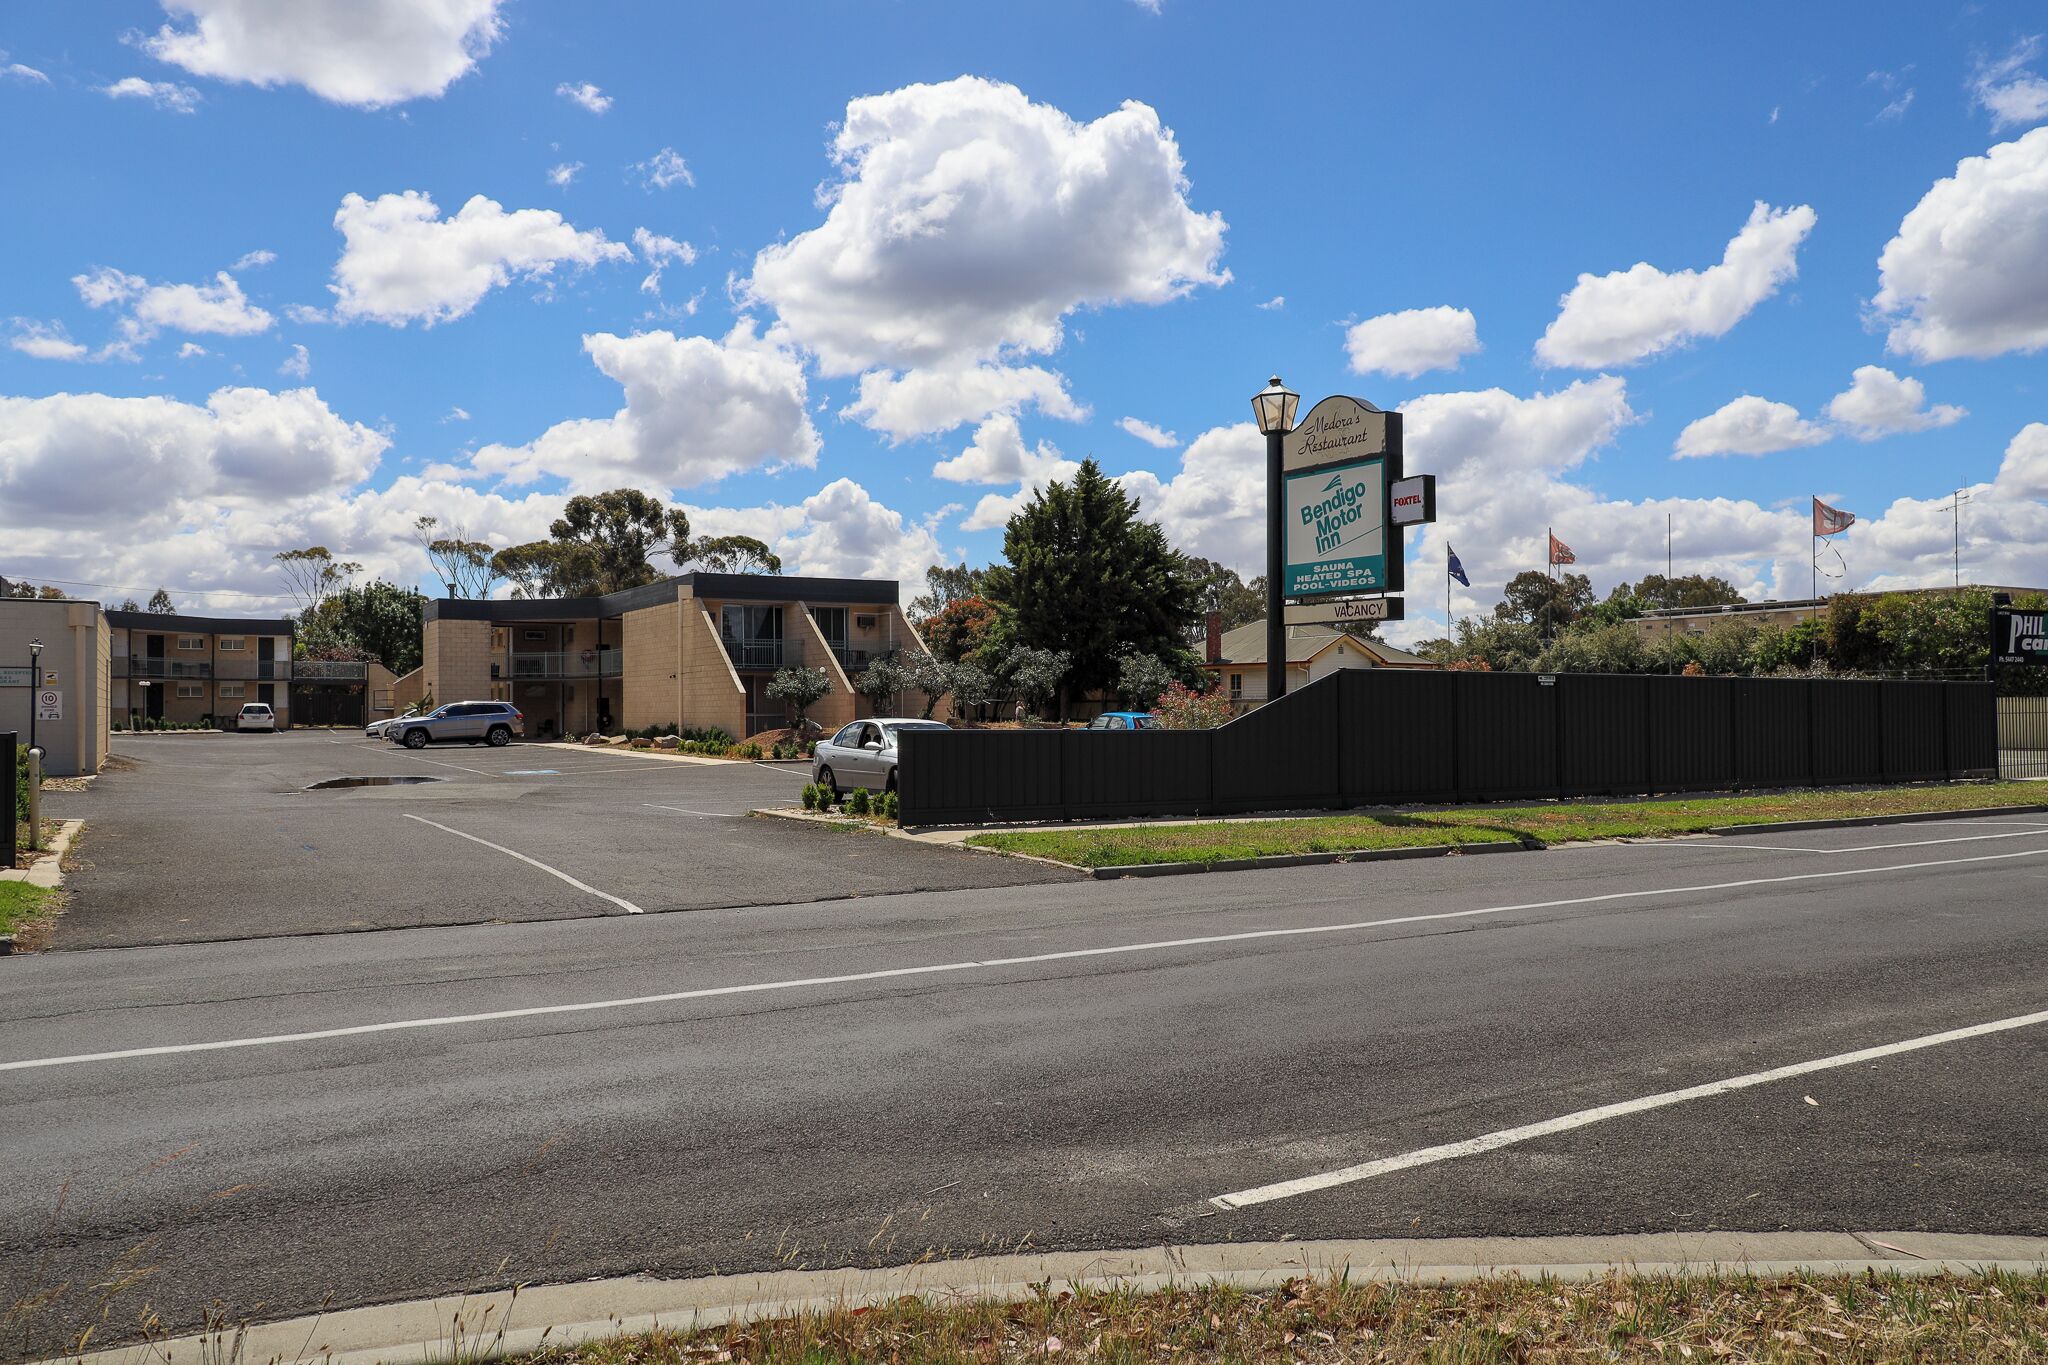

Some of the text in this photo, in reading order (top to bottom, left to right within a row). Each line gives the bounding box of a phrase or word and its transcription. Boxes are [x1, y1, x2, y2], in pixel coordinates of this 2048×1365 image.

[1303, 407, 1360, 435] Medora's
[1297, 427, 1368, 455] Restaurant
[1301, 482, 1366, 526] Bendigo
[1394, 495, 1421, 507] FOXTEL
[1316, 503, 1363, 538] Motor
[1315, 531, 1341, 554] Inn
[1296, 568, 1372, 583] HEATED SPA
[1313, 562, 1354, 573] SAUNA
[1293, 577, 1376, 591] POOL-VIDEOS
[1334, 603, 1384, 618] VACANCY
[2007, 614, 2046, 654] PHIL
